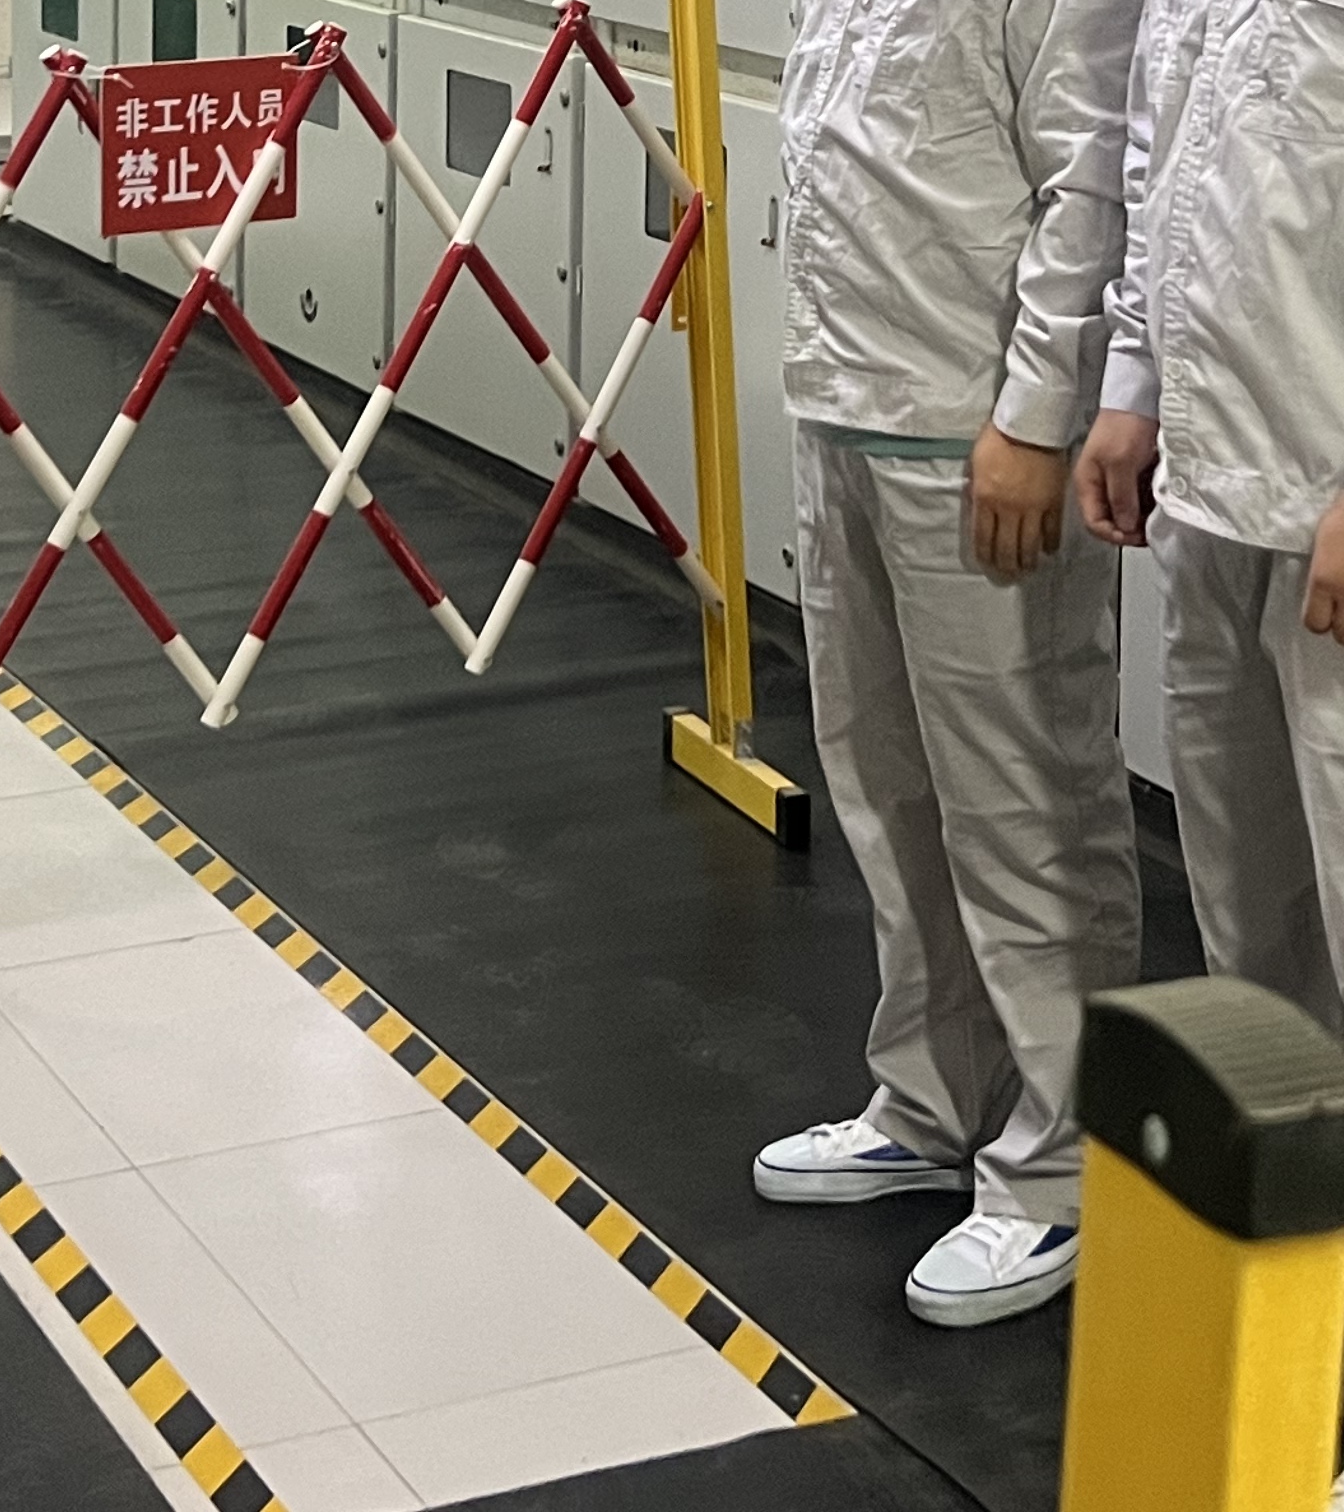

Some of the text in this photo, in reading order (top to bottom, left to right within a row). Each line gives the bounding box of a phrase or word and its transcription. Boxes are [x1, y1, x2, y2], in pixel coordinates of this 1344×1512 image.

[115, 89, 283, 139] 非工作人员
